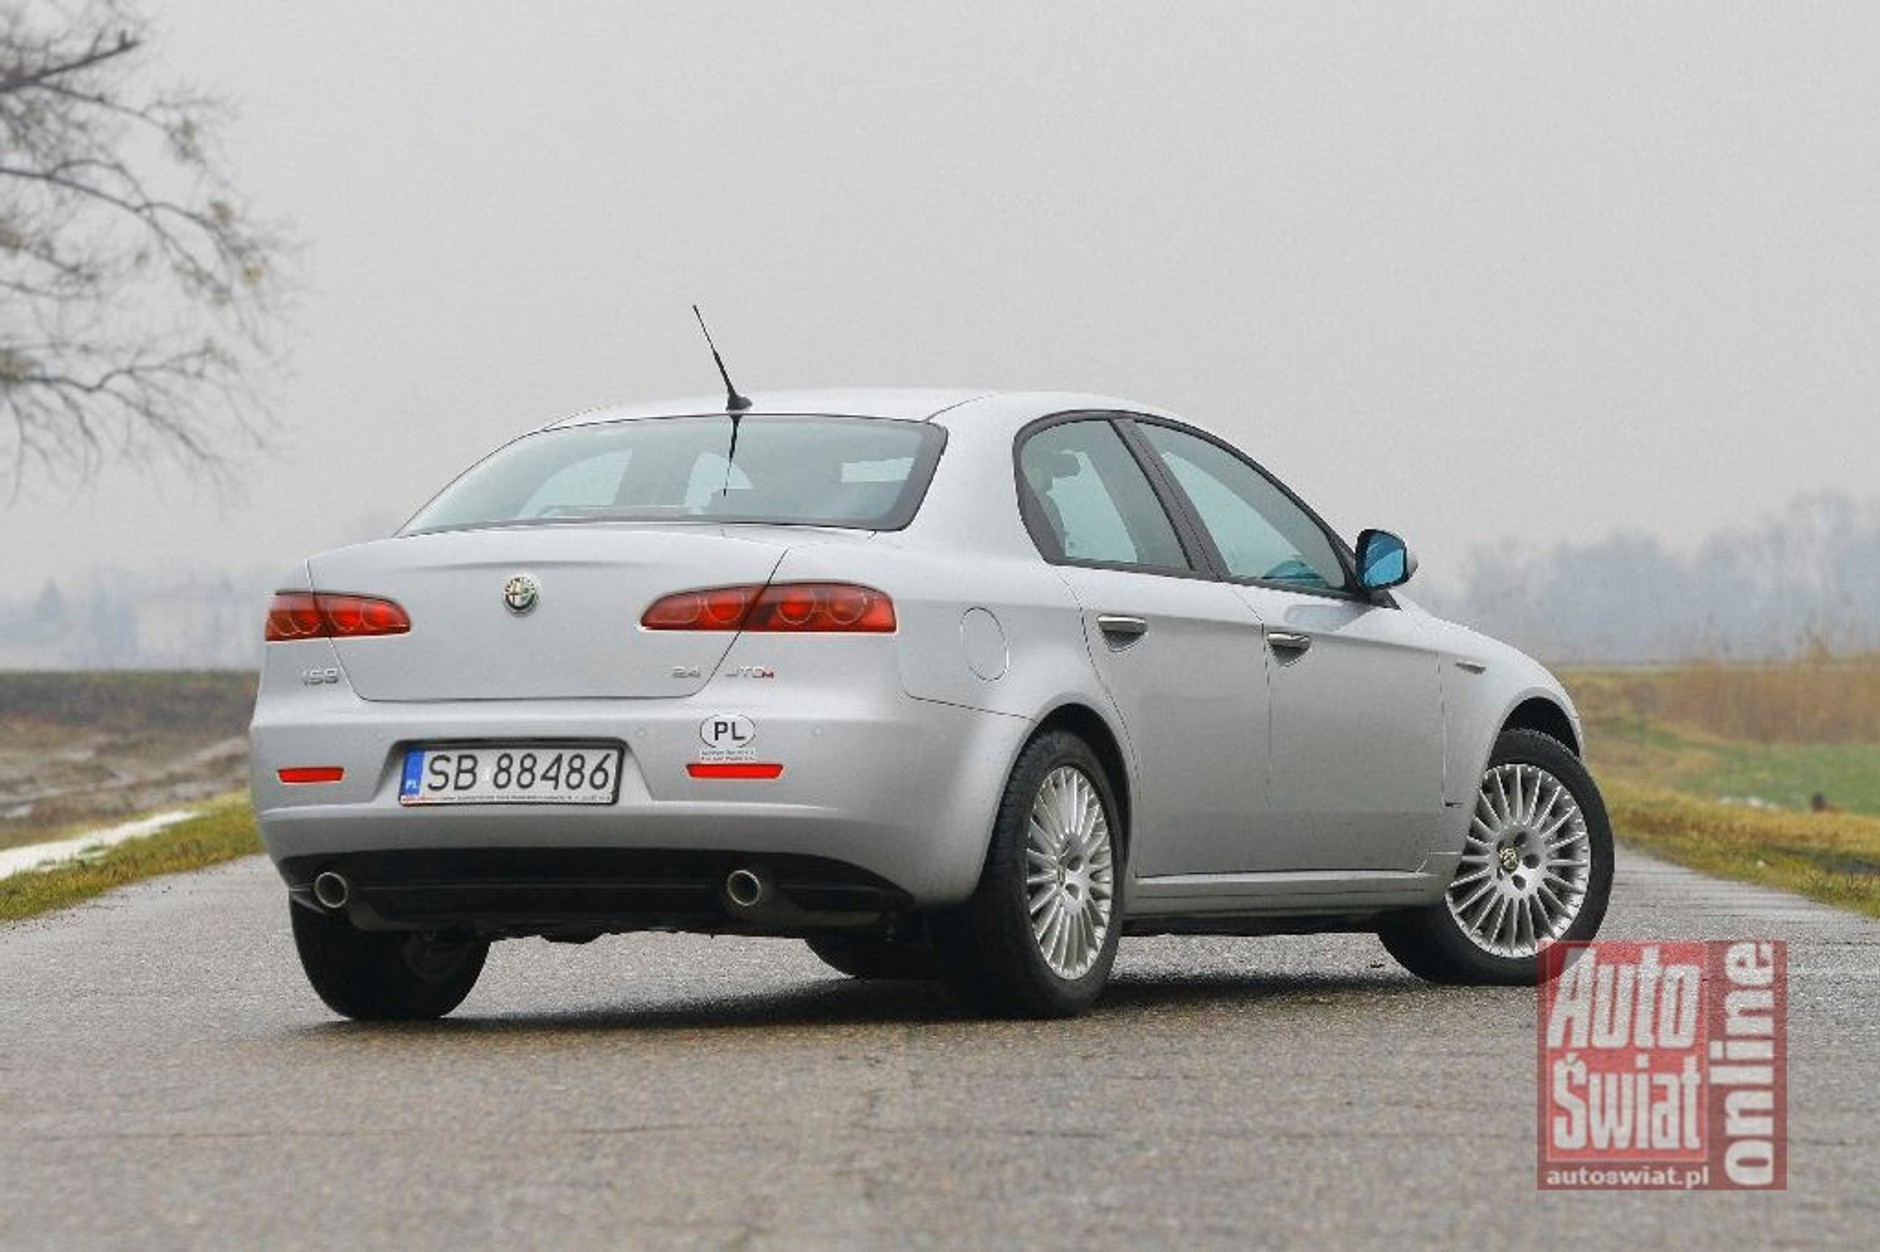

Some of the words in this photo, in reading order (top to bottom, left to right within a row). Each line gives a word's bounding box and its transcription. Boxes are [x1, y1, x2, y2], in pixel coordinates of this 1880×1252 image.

[713, 721, 746, 741] PL
[427, 753, 479, 791] SB
[492, 752, 612, 791] 88486
